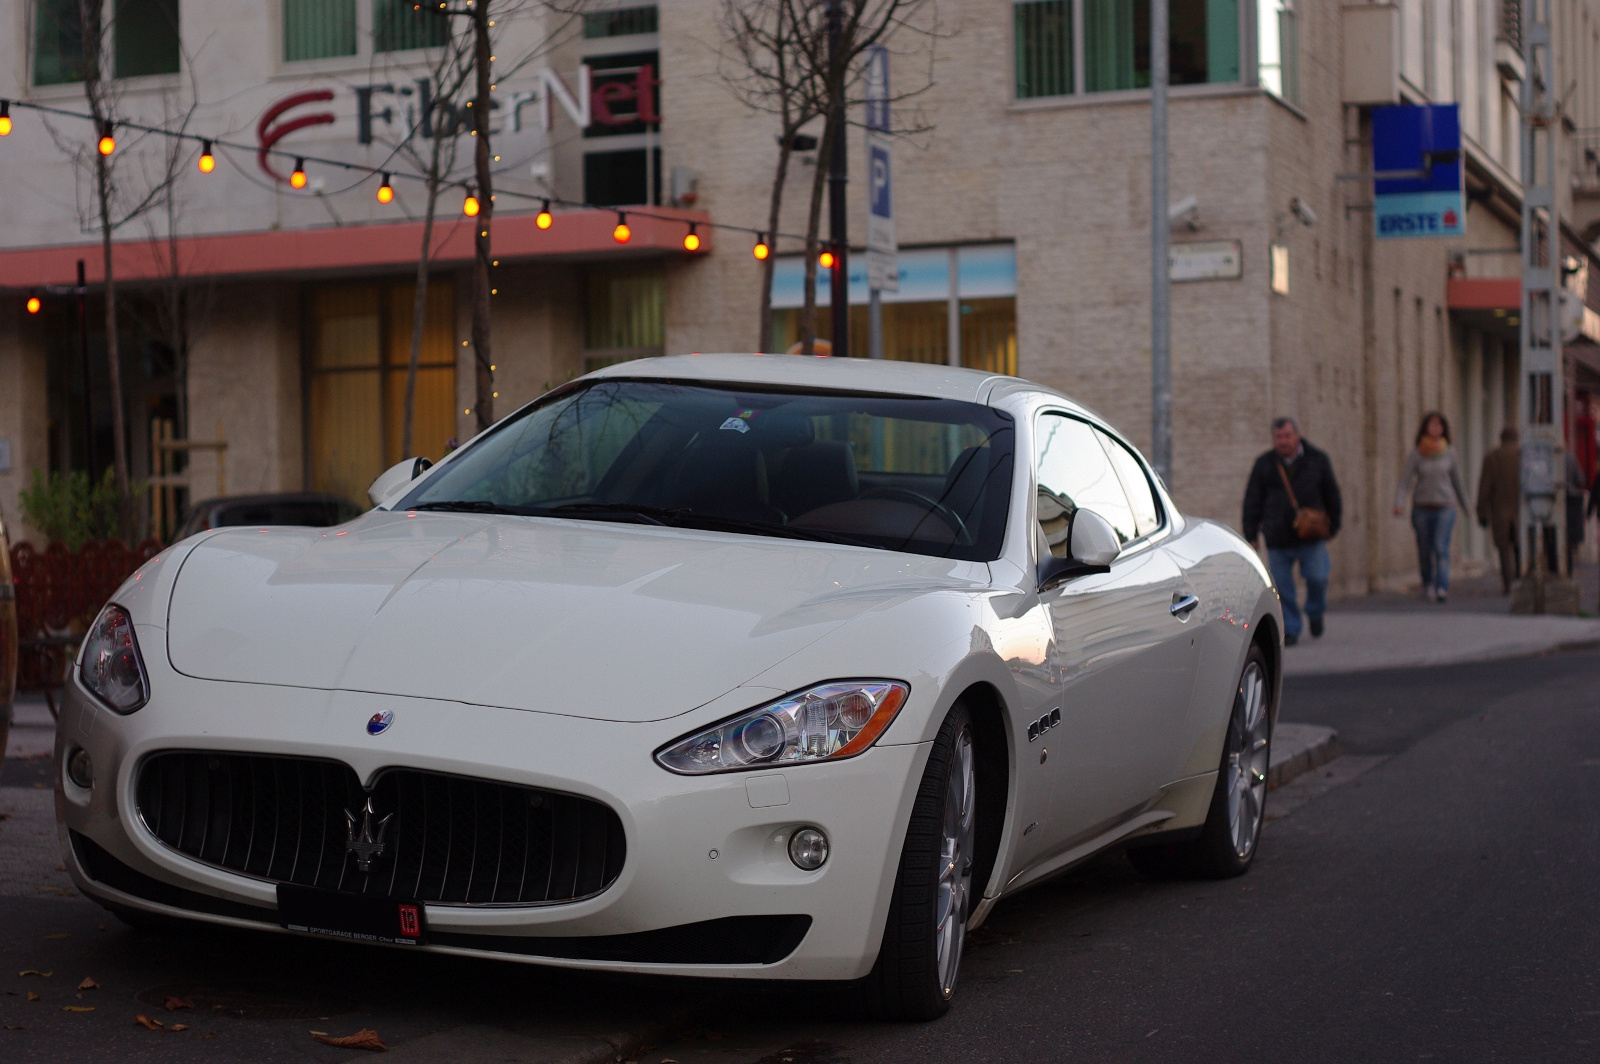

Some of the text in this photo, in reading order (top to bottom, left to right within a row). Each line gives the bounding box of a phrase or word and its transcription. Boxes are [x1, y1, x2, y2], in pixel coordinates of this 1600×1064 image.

[351, 63, 659, 146] FiberNet
[872, 156, 888, 205] P
[1379, 211, 1438, 234] ERSTE
[309, 926, 353, 939] SPORTGARAGE
